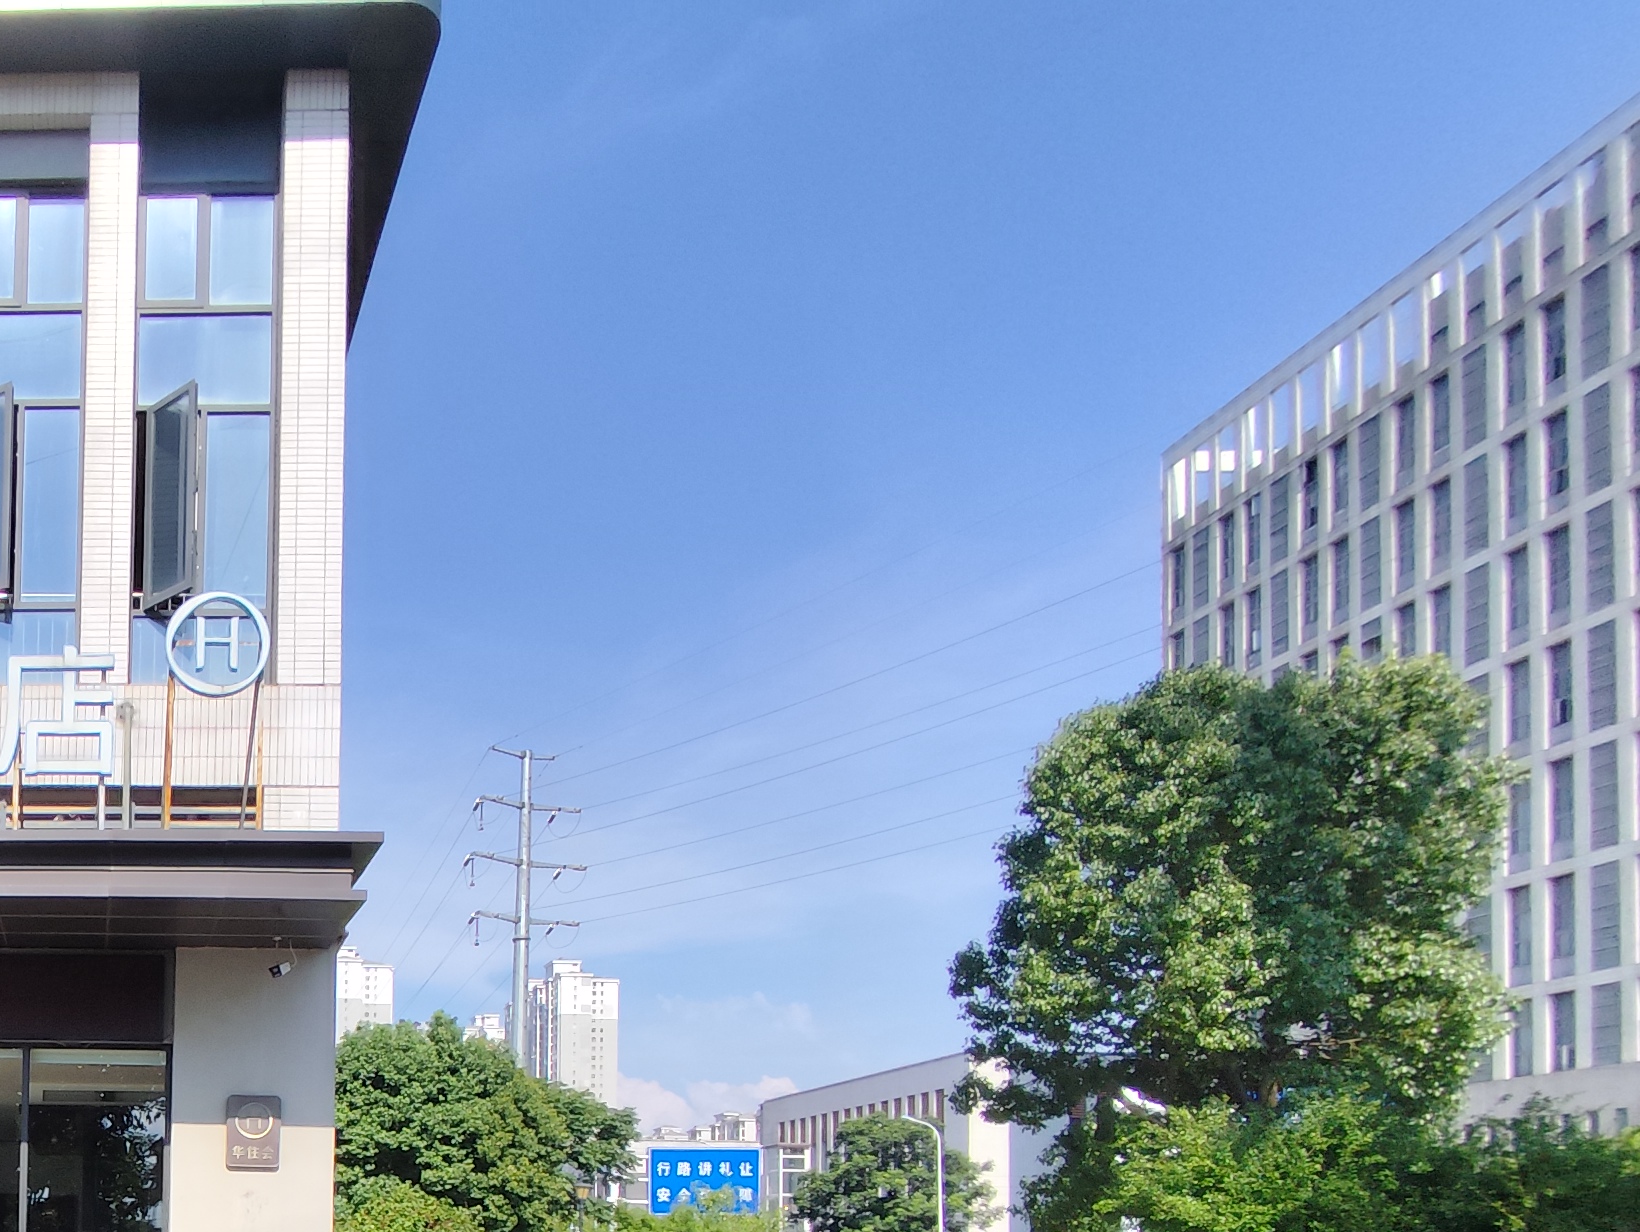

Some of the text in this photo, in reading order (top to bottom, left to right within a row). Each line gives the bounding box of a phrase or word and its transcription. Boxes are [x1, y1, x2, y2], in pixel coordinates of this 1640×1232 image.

[231, 1145, 274, 1160] 华住会
[656, 1161, 754, 1177] 行路讲礼让
